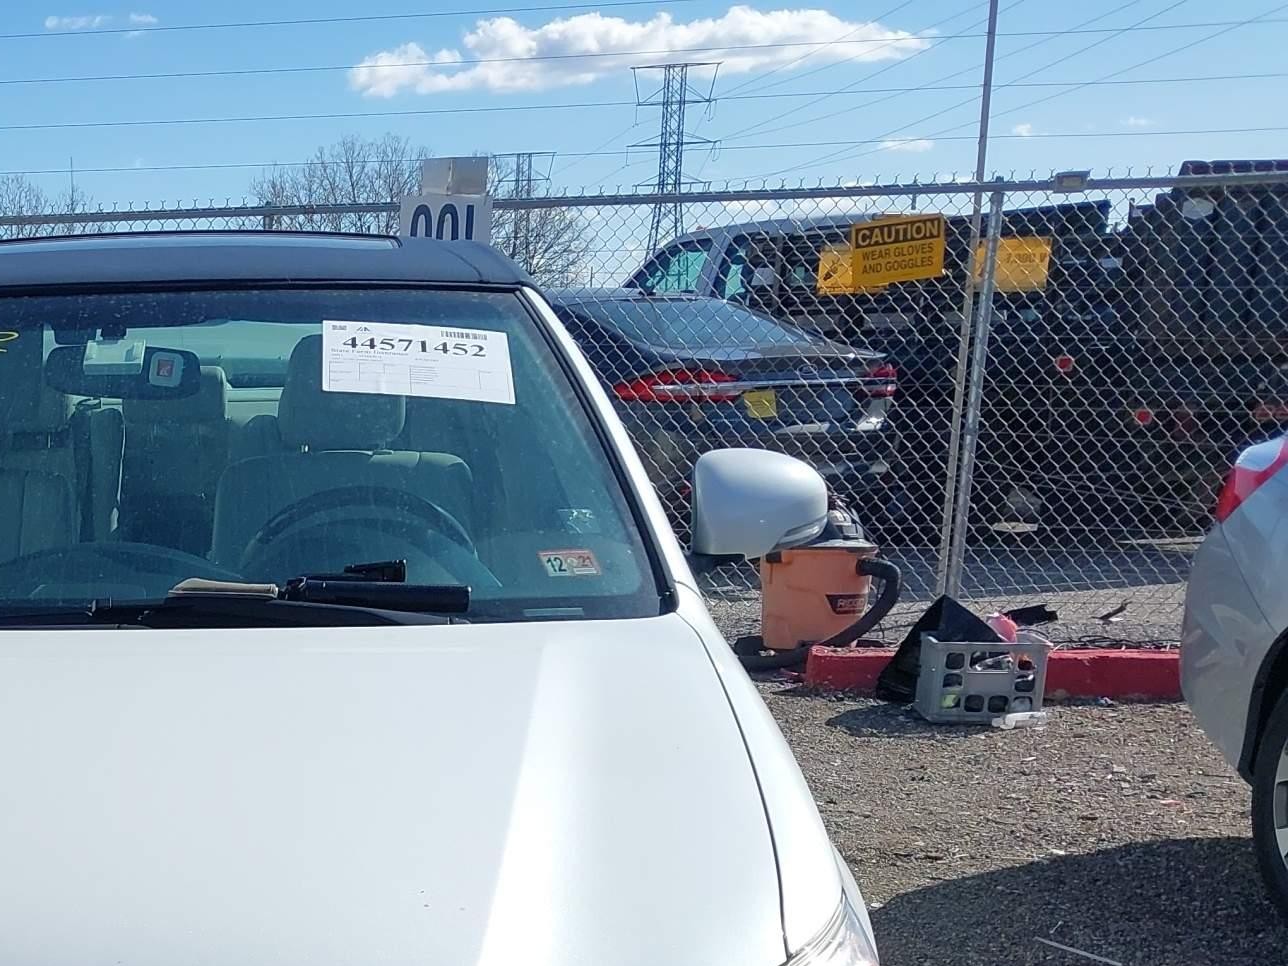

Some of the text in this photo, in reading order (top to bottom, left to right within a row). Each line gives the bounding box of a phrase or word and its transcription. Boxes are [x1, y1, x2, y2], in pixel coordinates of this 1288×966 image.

[857, 220, 939, 246] CAUTION
[862, 242, 935, 261] WEAR GLOVES
[862, 256, 934, 274] AND GOGGLES
[342, 336, 487, 358] 44571452
[546, 556, 568, 573] 12
